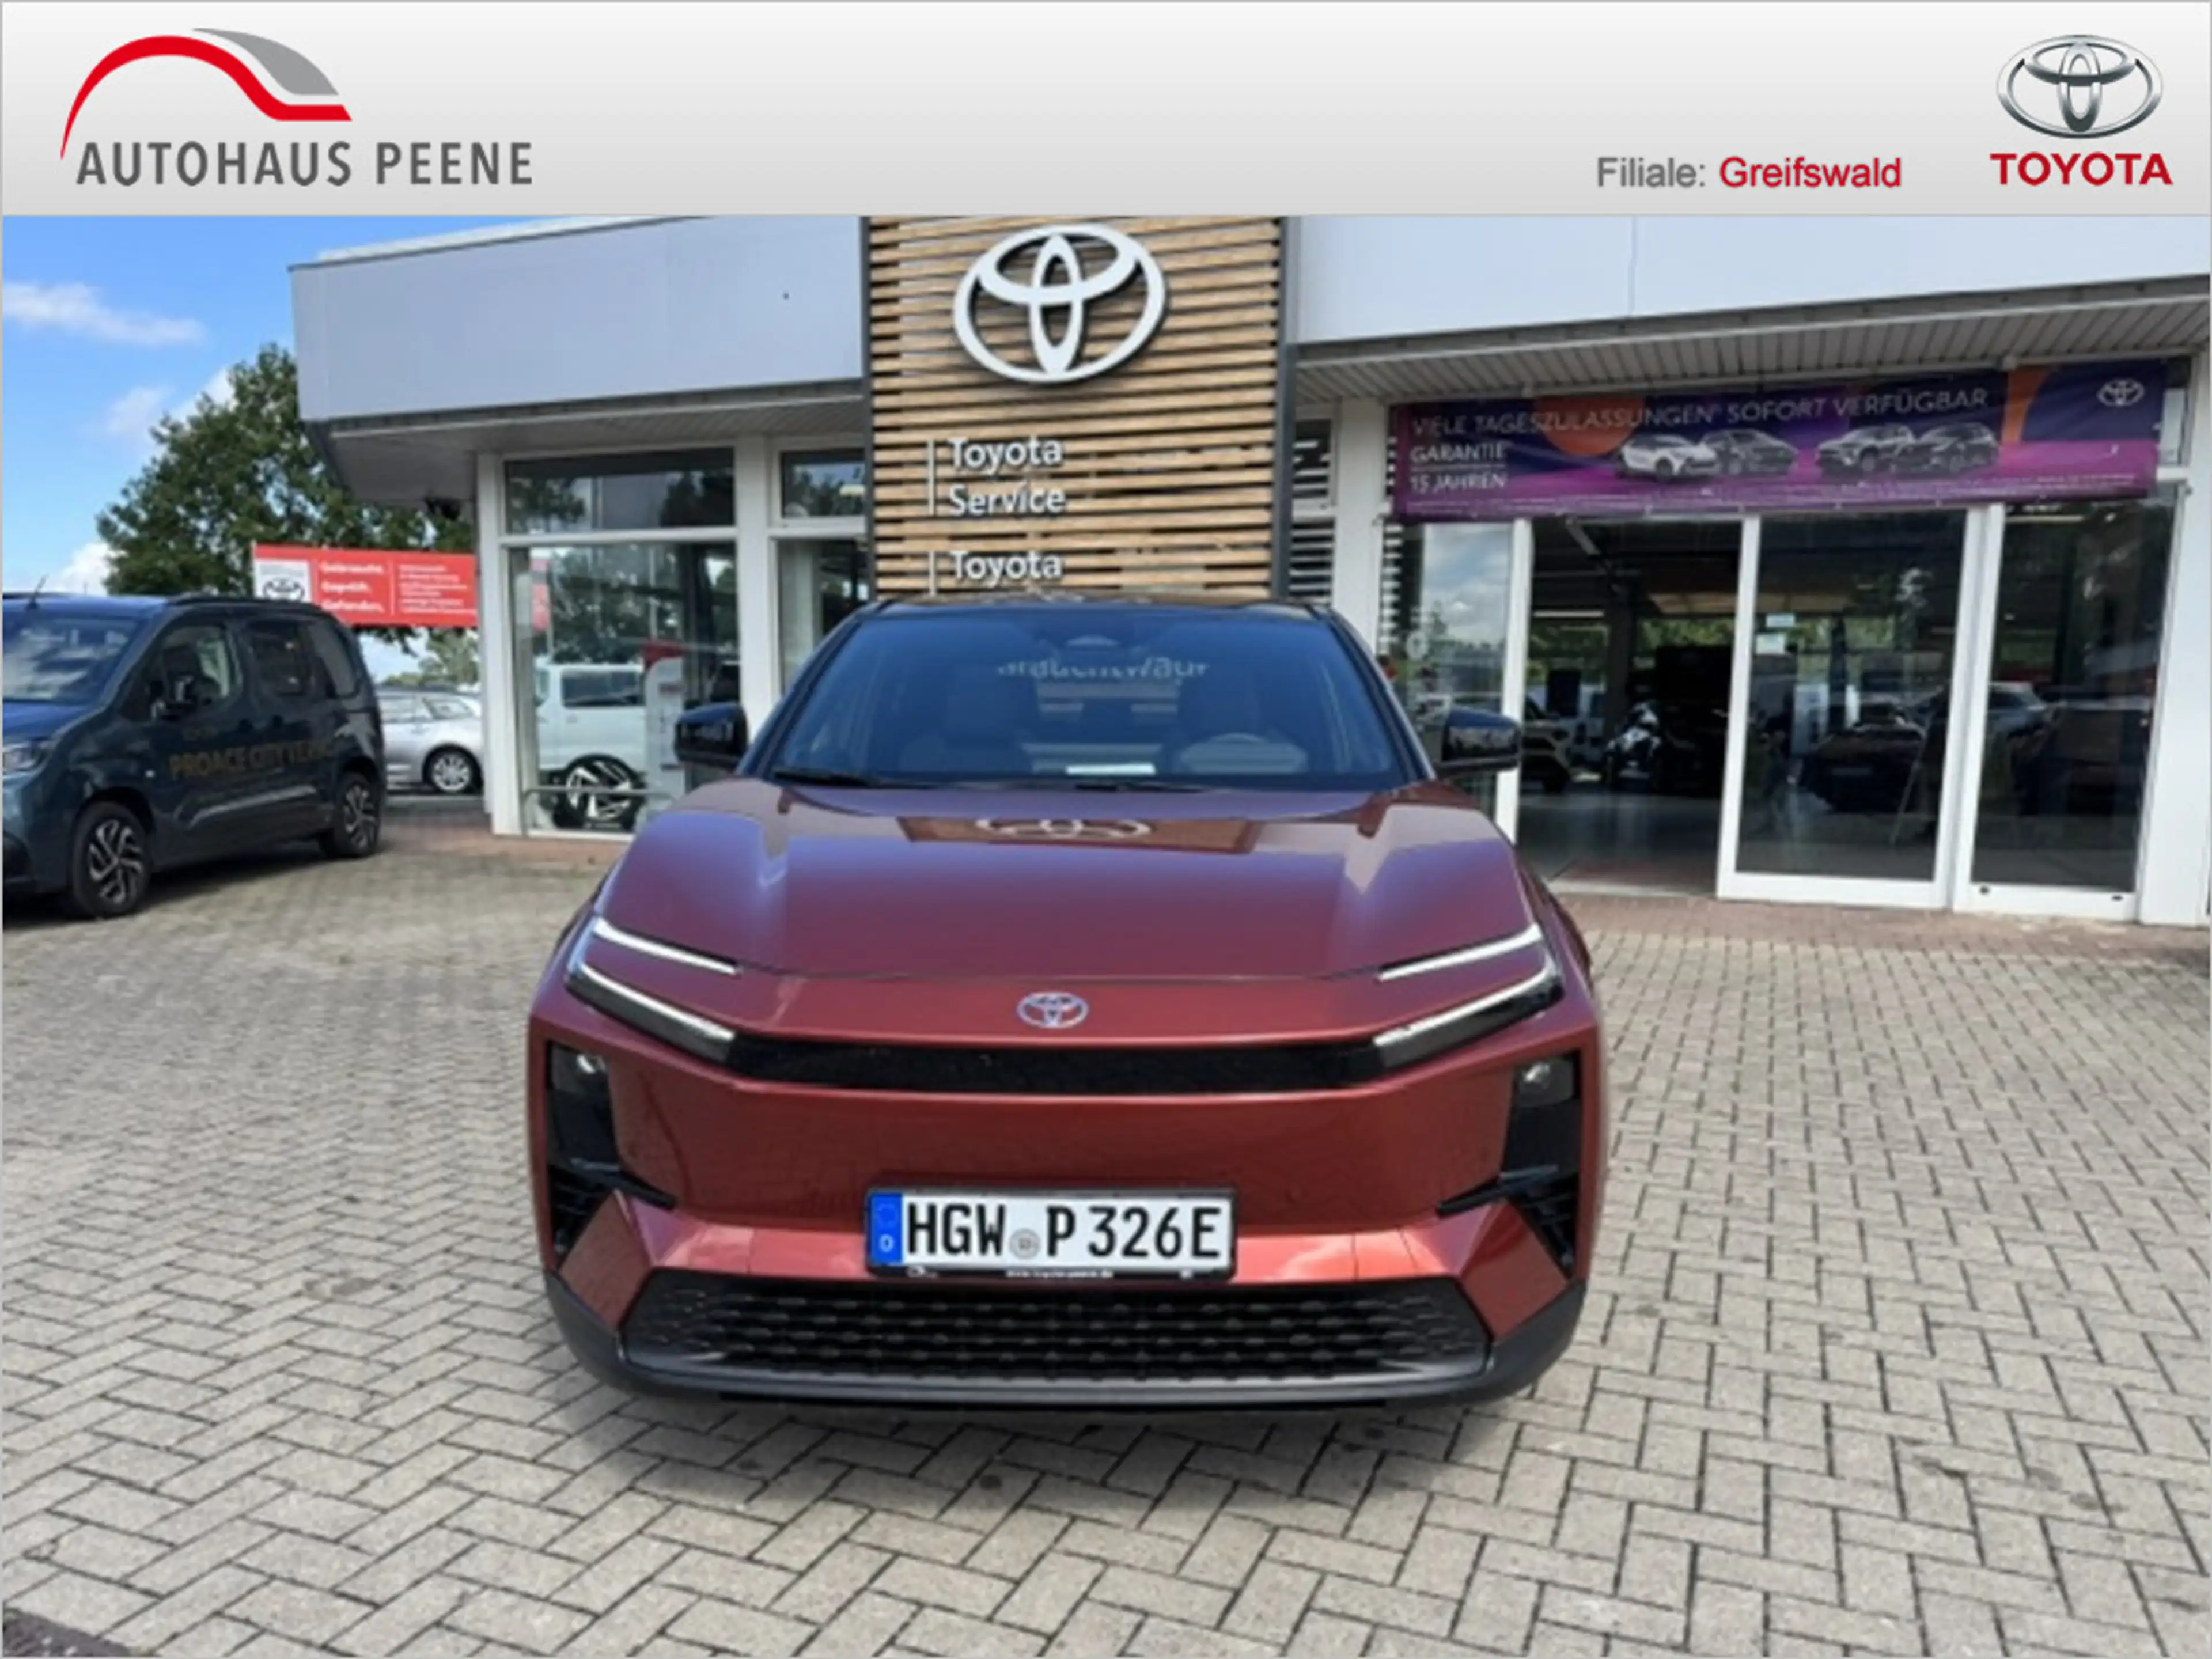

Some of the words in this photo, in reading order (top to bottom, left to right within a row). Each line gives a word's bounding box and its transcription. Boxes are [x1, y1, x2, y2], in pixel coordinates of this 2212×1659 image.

[1727, 396, 1827, 424] SOFORT
[1832, 386, 1989, 416] VERFÜGBAR
[947, 435, 1064, 475] Toyota
[948, 482, 1066, 516] Service
[947, 550, 1064, 588] Toyota
[907, 1202, 1006, 1256] HGW
[1046, 1205, 1077, 1257] P
[1088, 1206, 1221, 1259] 326E
